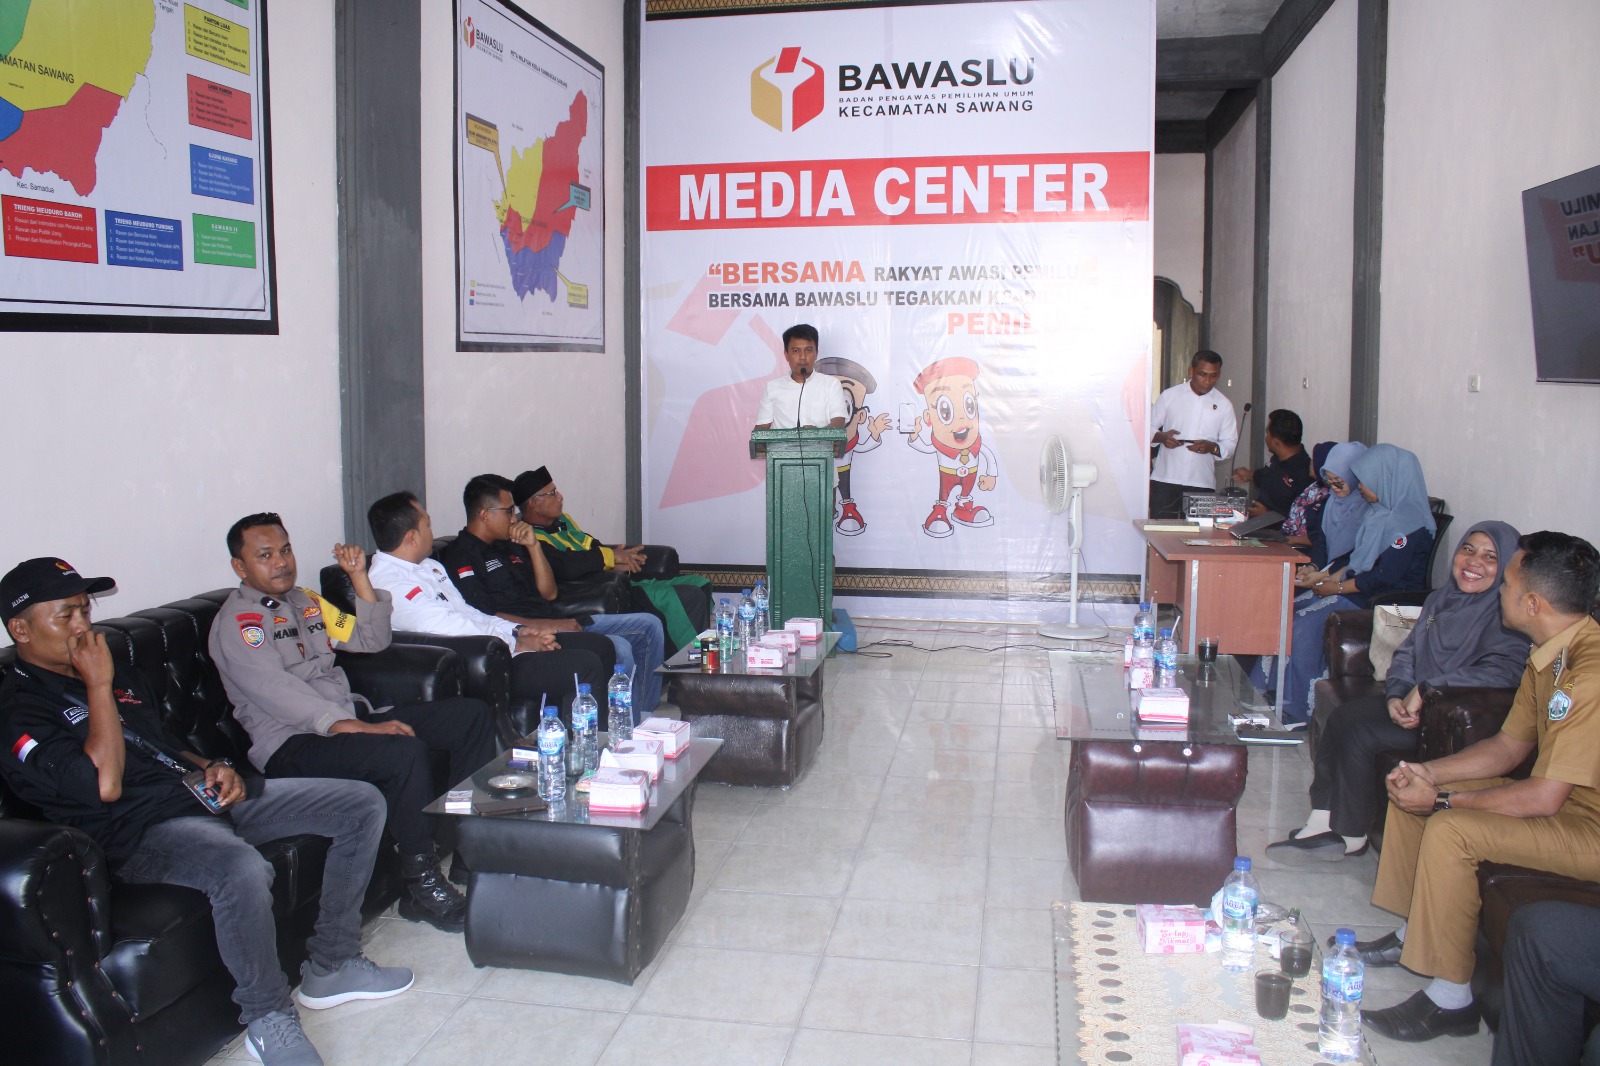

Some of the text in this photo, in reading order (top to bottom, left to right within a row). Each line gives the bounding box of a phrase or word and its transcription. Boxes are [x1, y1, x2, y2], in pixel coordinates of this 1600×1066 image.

[476, 28, 504, 54] BAWASLU
[38, 64, 75, 84] SAWANG
[838, 57, 1035, 92] BAWASLU
[879, 94, 936, 102] PENGAWAS
[838, 100, 1034, 118] KECAMATAN SAWANG
[16, 181, 54, 194] Kec. Samadua
[679, 162, 1110, 221] MEDIA CENTER
[14, 204, 35, 212] TRIENG
[37, 207, 63, 216] MEUDURO
[115, 218, 132, 226] TRIENG
[708, 260, 866, 284] “BERSAMA
[874, 266, 943, 282] RAKYAT
[708, 292, 790, 308] BERSAMA
[794, 290, 878, 306] BAWASLU
[884, 290, 982, 306] TEGAKKAN
[1224, 898, 1245, 910] AQUA
[1158, 937, 1190, 946] Nikmat
